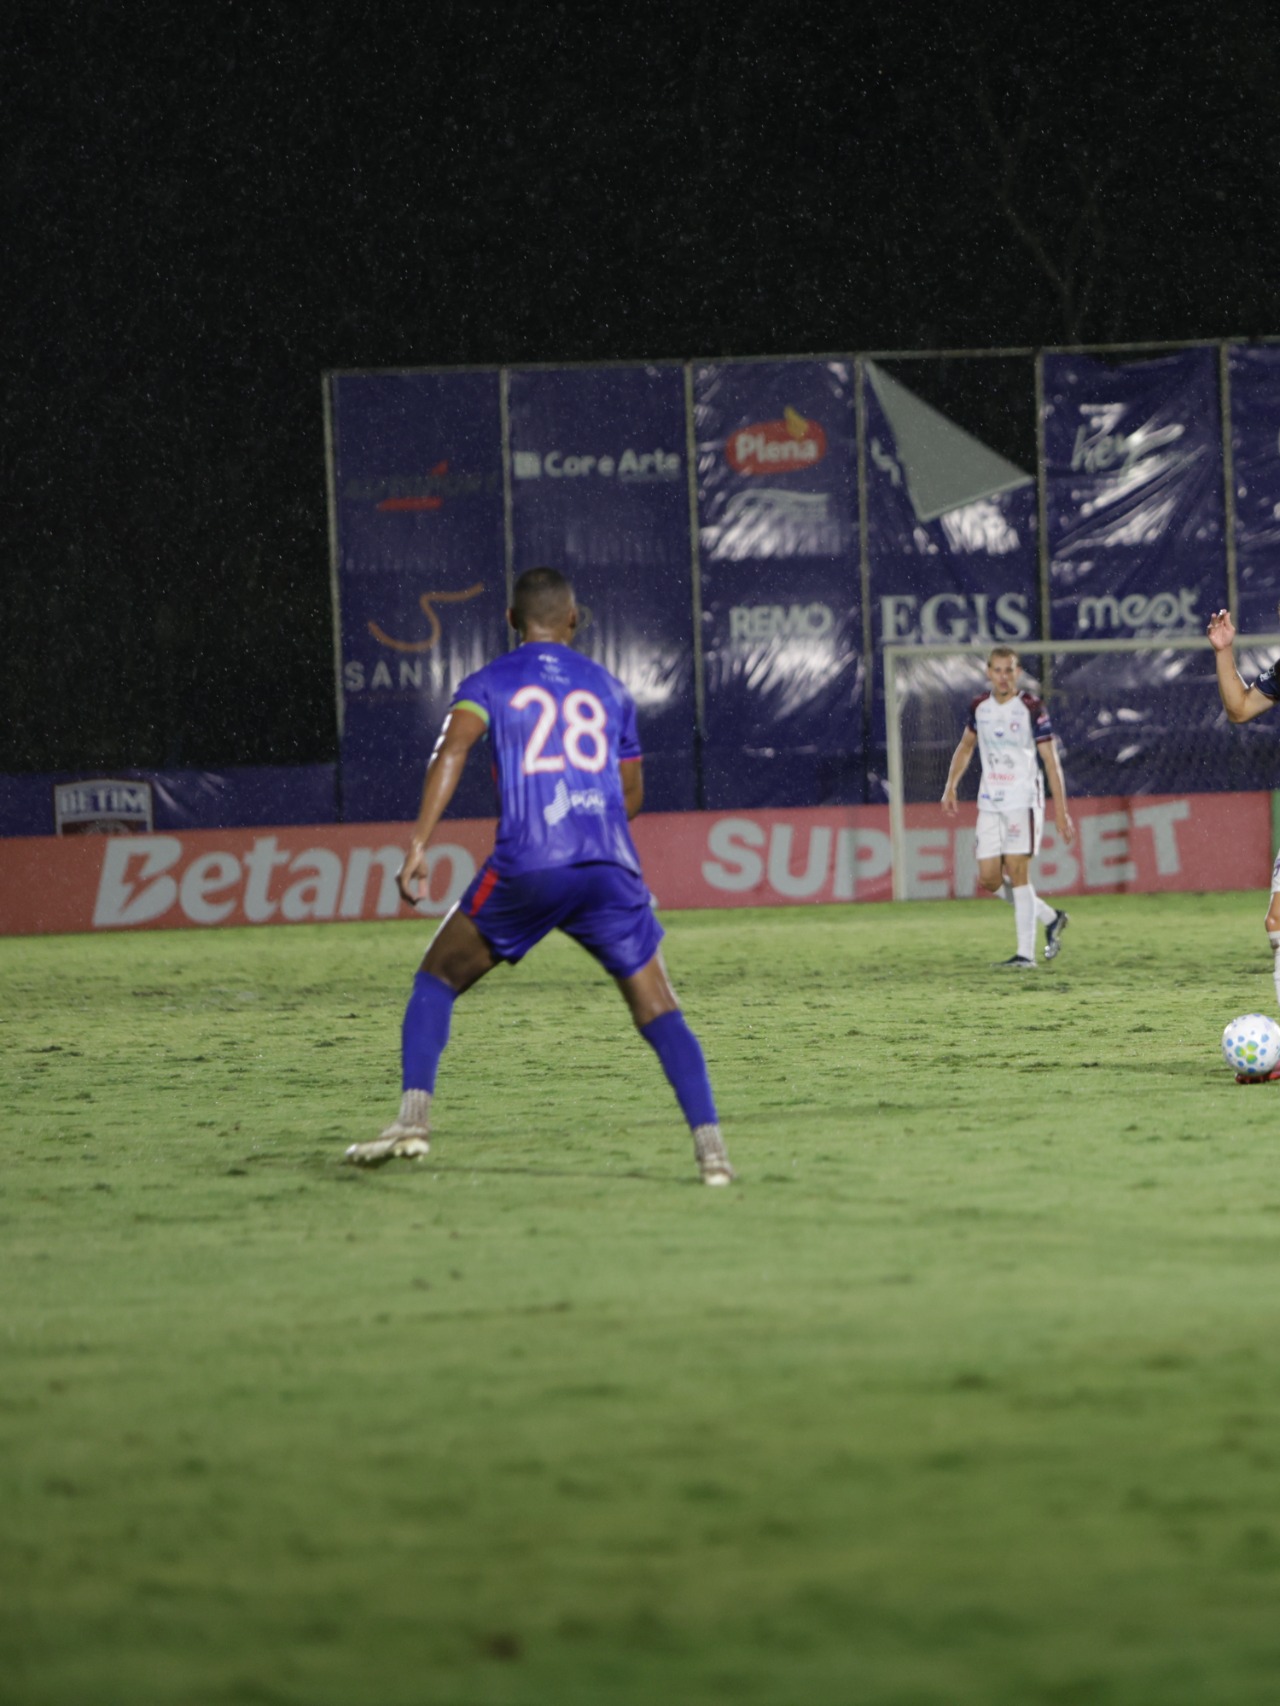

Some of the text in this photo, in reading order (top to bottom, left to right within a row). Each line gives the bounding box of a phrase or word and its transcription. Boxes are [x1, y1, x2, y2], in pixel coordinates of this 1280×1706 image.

[618, 448, 682, 473] Arte
[735, 432, 819, 465] Plena
[729, 603, 833, 639] REMO
[880, 593, 1031, 640] EGIS
[509, 685, 609, 775] 28
[61, 787, 147, 814] BETIM
[92, 835, 477, 928] Betano
